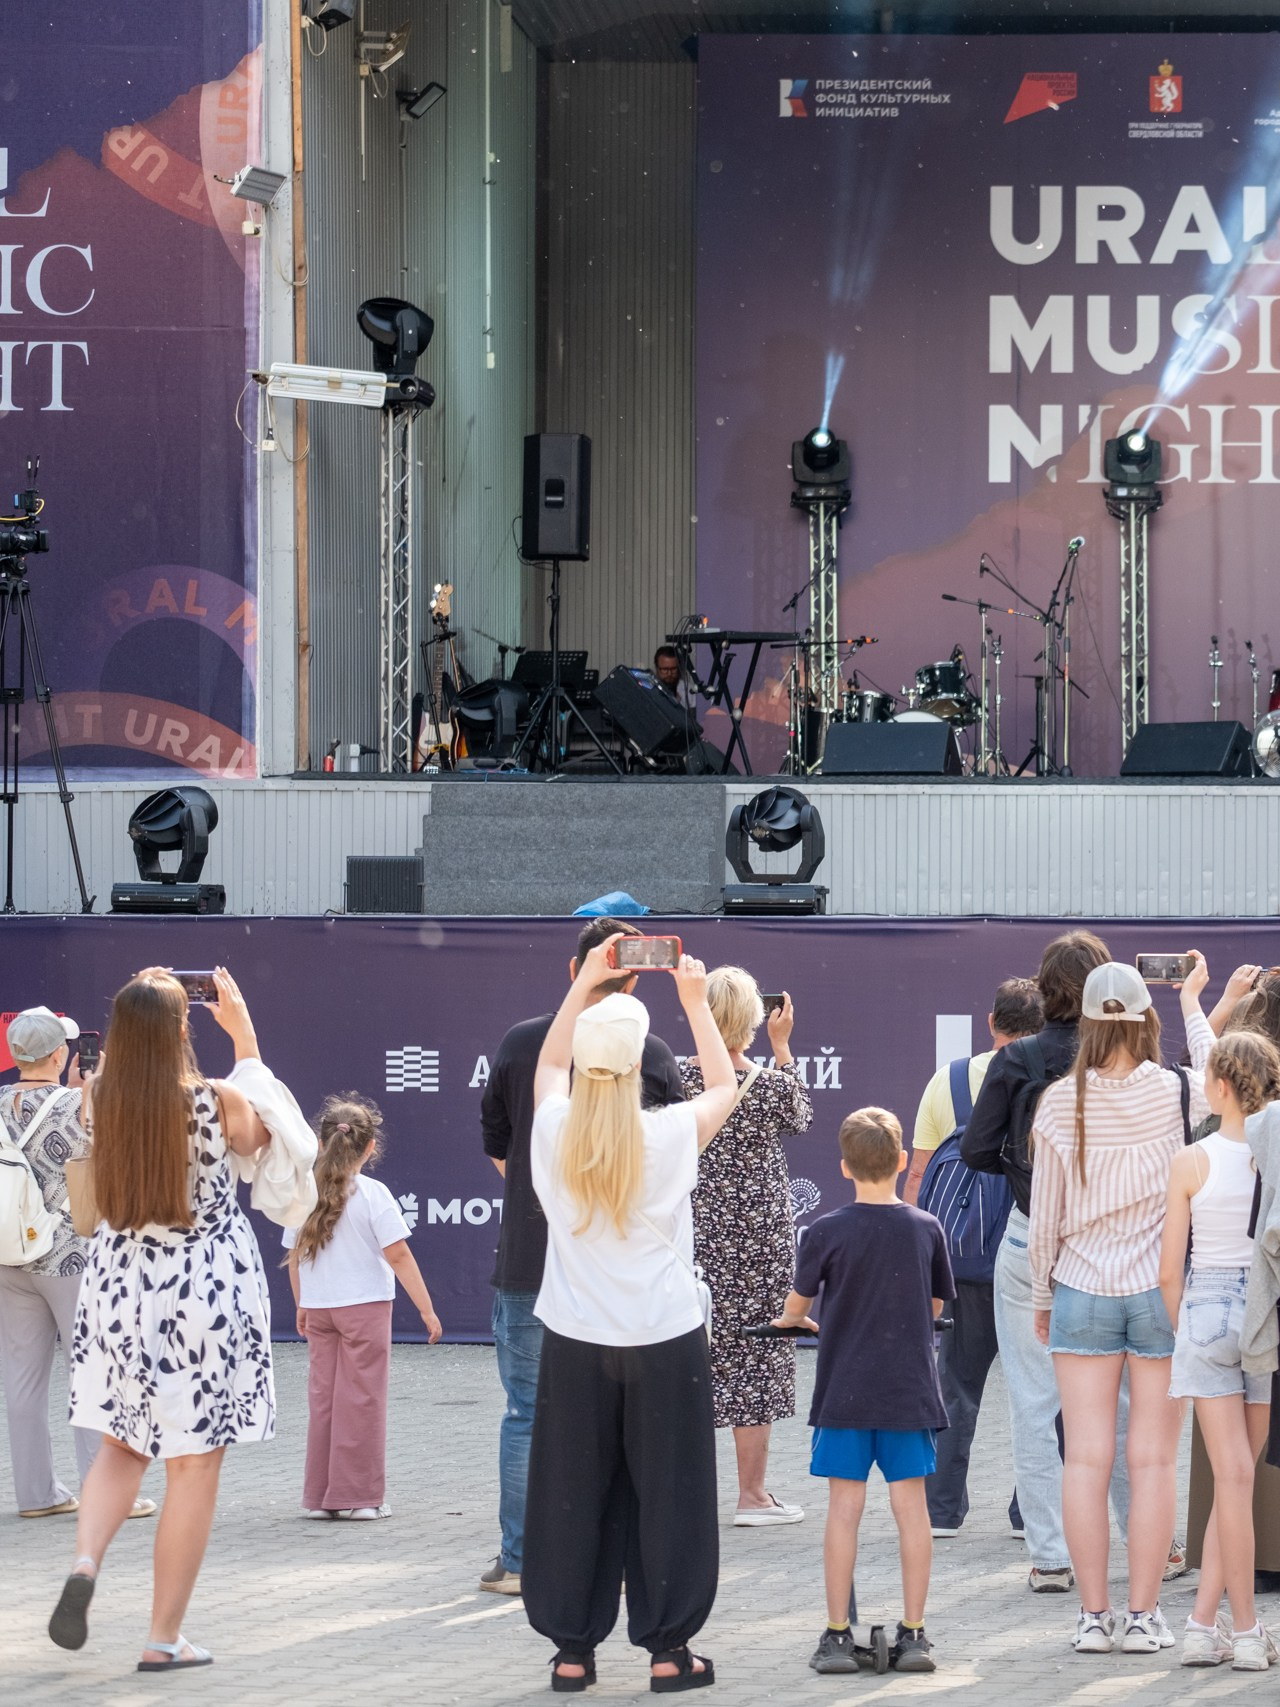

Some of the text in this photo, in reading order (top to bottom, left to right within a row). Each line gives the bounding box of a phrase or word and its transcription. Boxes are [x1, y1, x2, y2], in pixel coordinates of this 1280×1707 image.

[815, 78, 932, 90] ПРЕЗИДЕНТСКИЙ
[815, 93, 951, 105] ФОНД КУЛЬТУРНЫХ
[815, 107, 899, 119] ИНИЦИАТИВ
